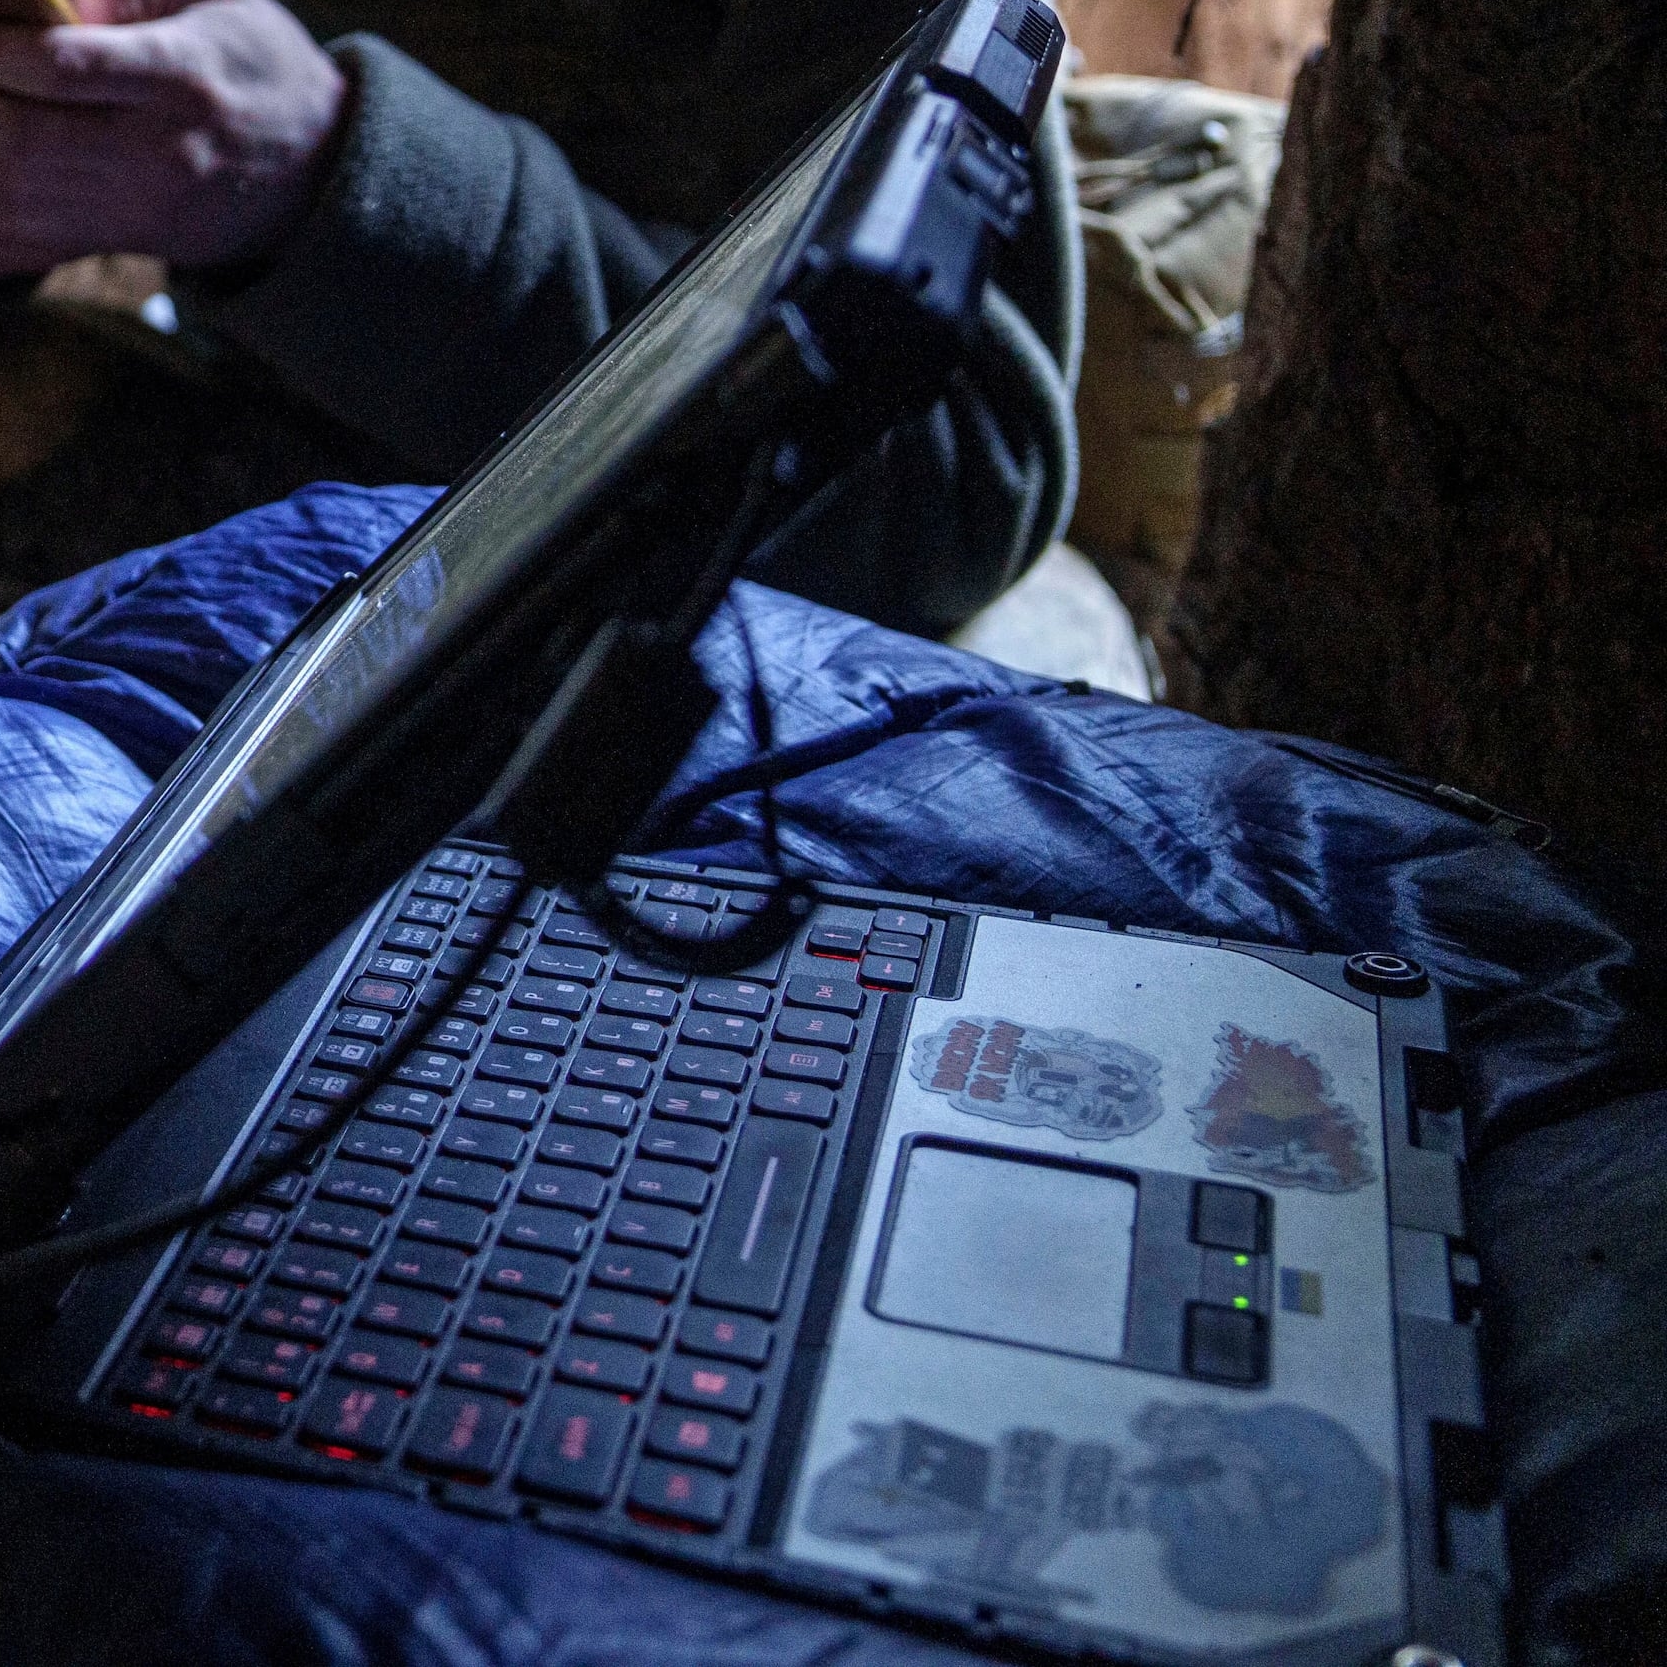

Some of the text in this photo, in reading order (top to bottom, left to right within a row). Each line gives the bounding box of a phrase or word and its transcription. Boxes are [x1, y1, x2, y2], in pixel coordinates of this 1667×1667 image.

[424, 875, 443, 891] Scroll
[437, 880, 454, 893] Lock
[394, 928, 414, 942] Num
[408, 930, 427, 944] Lock
[376, 957, 392, 968] F12
[816, 985, 833, 998] Del
[805, 1020, 825, 1031] Ins
[784, 1091, 802, 1105] Alt
